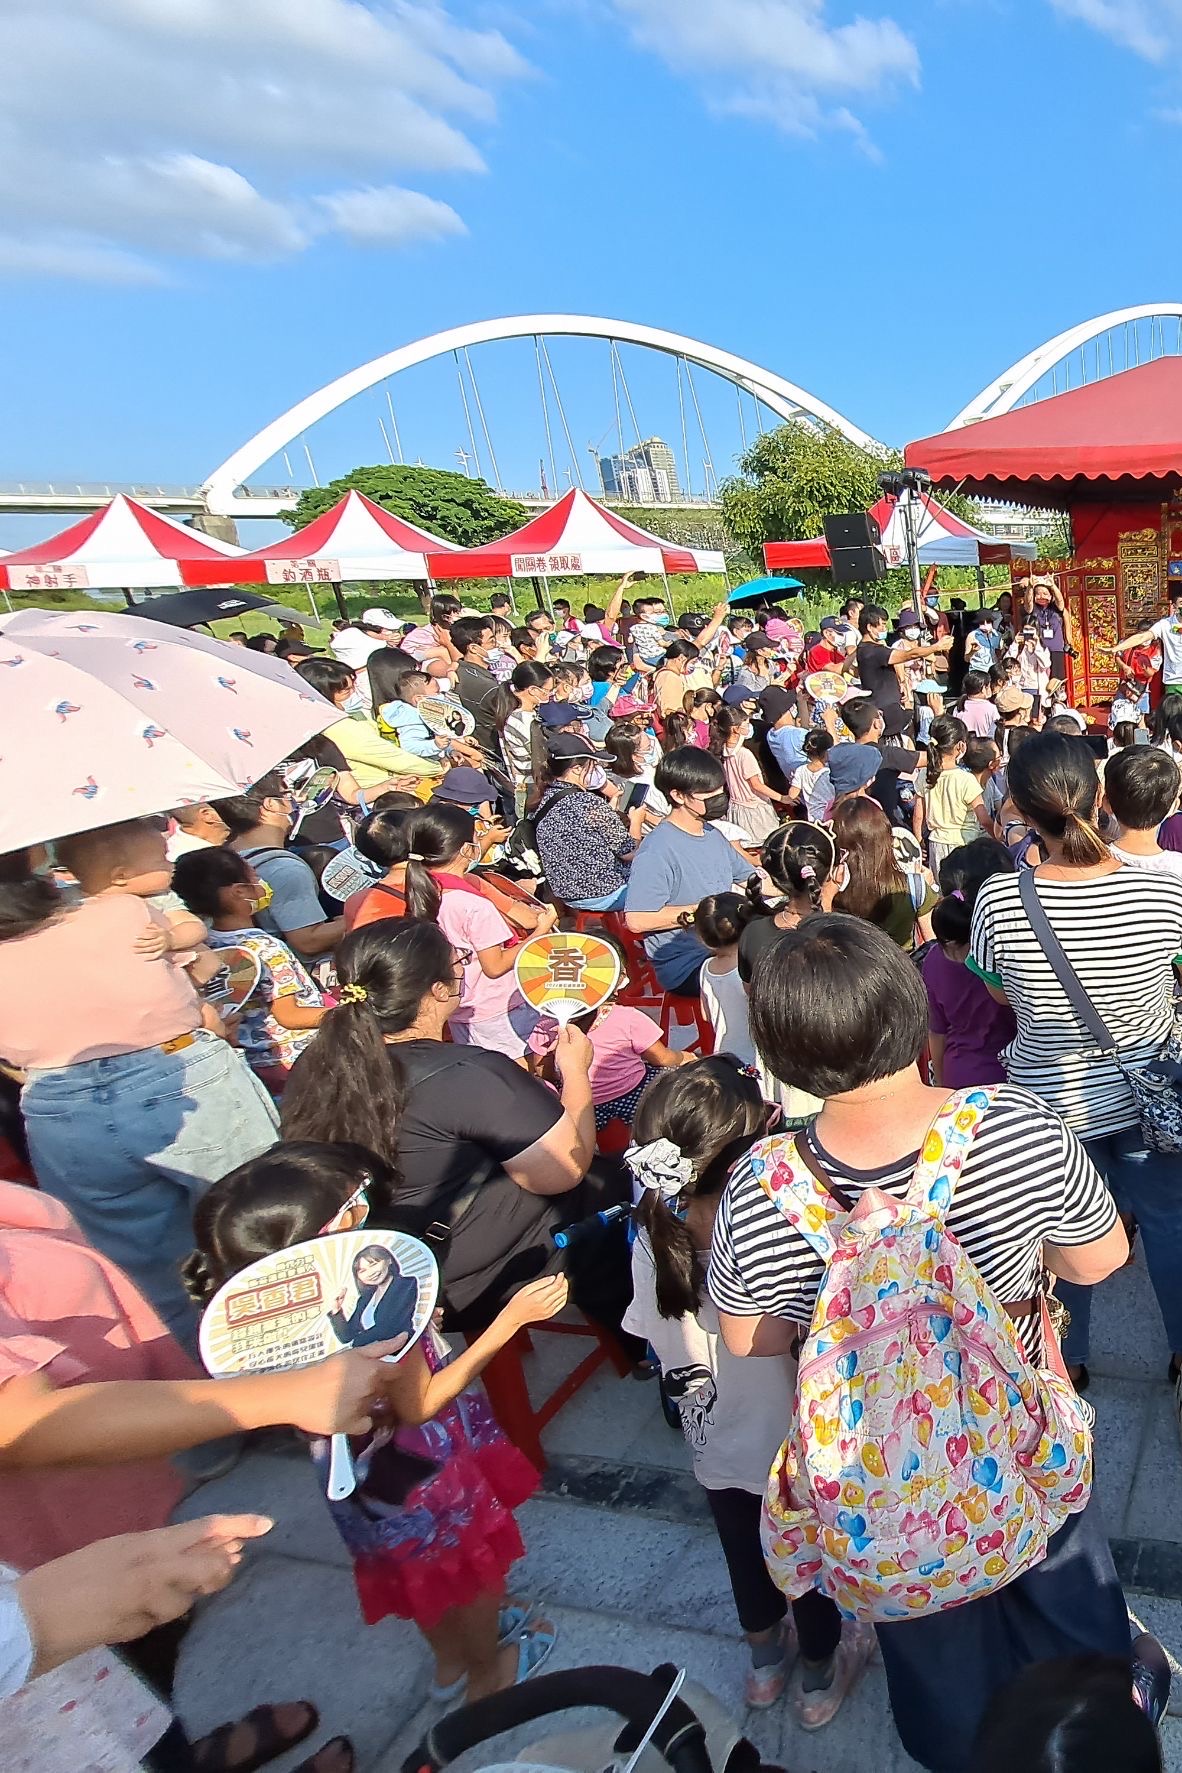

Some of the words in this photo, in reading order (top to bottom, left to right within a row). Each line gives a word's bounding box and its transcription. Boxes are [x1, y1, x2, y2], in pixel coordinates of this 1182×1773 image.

[547, 947, 587, 983] 香
[228, 1277, 320, 1322] 吳香君
